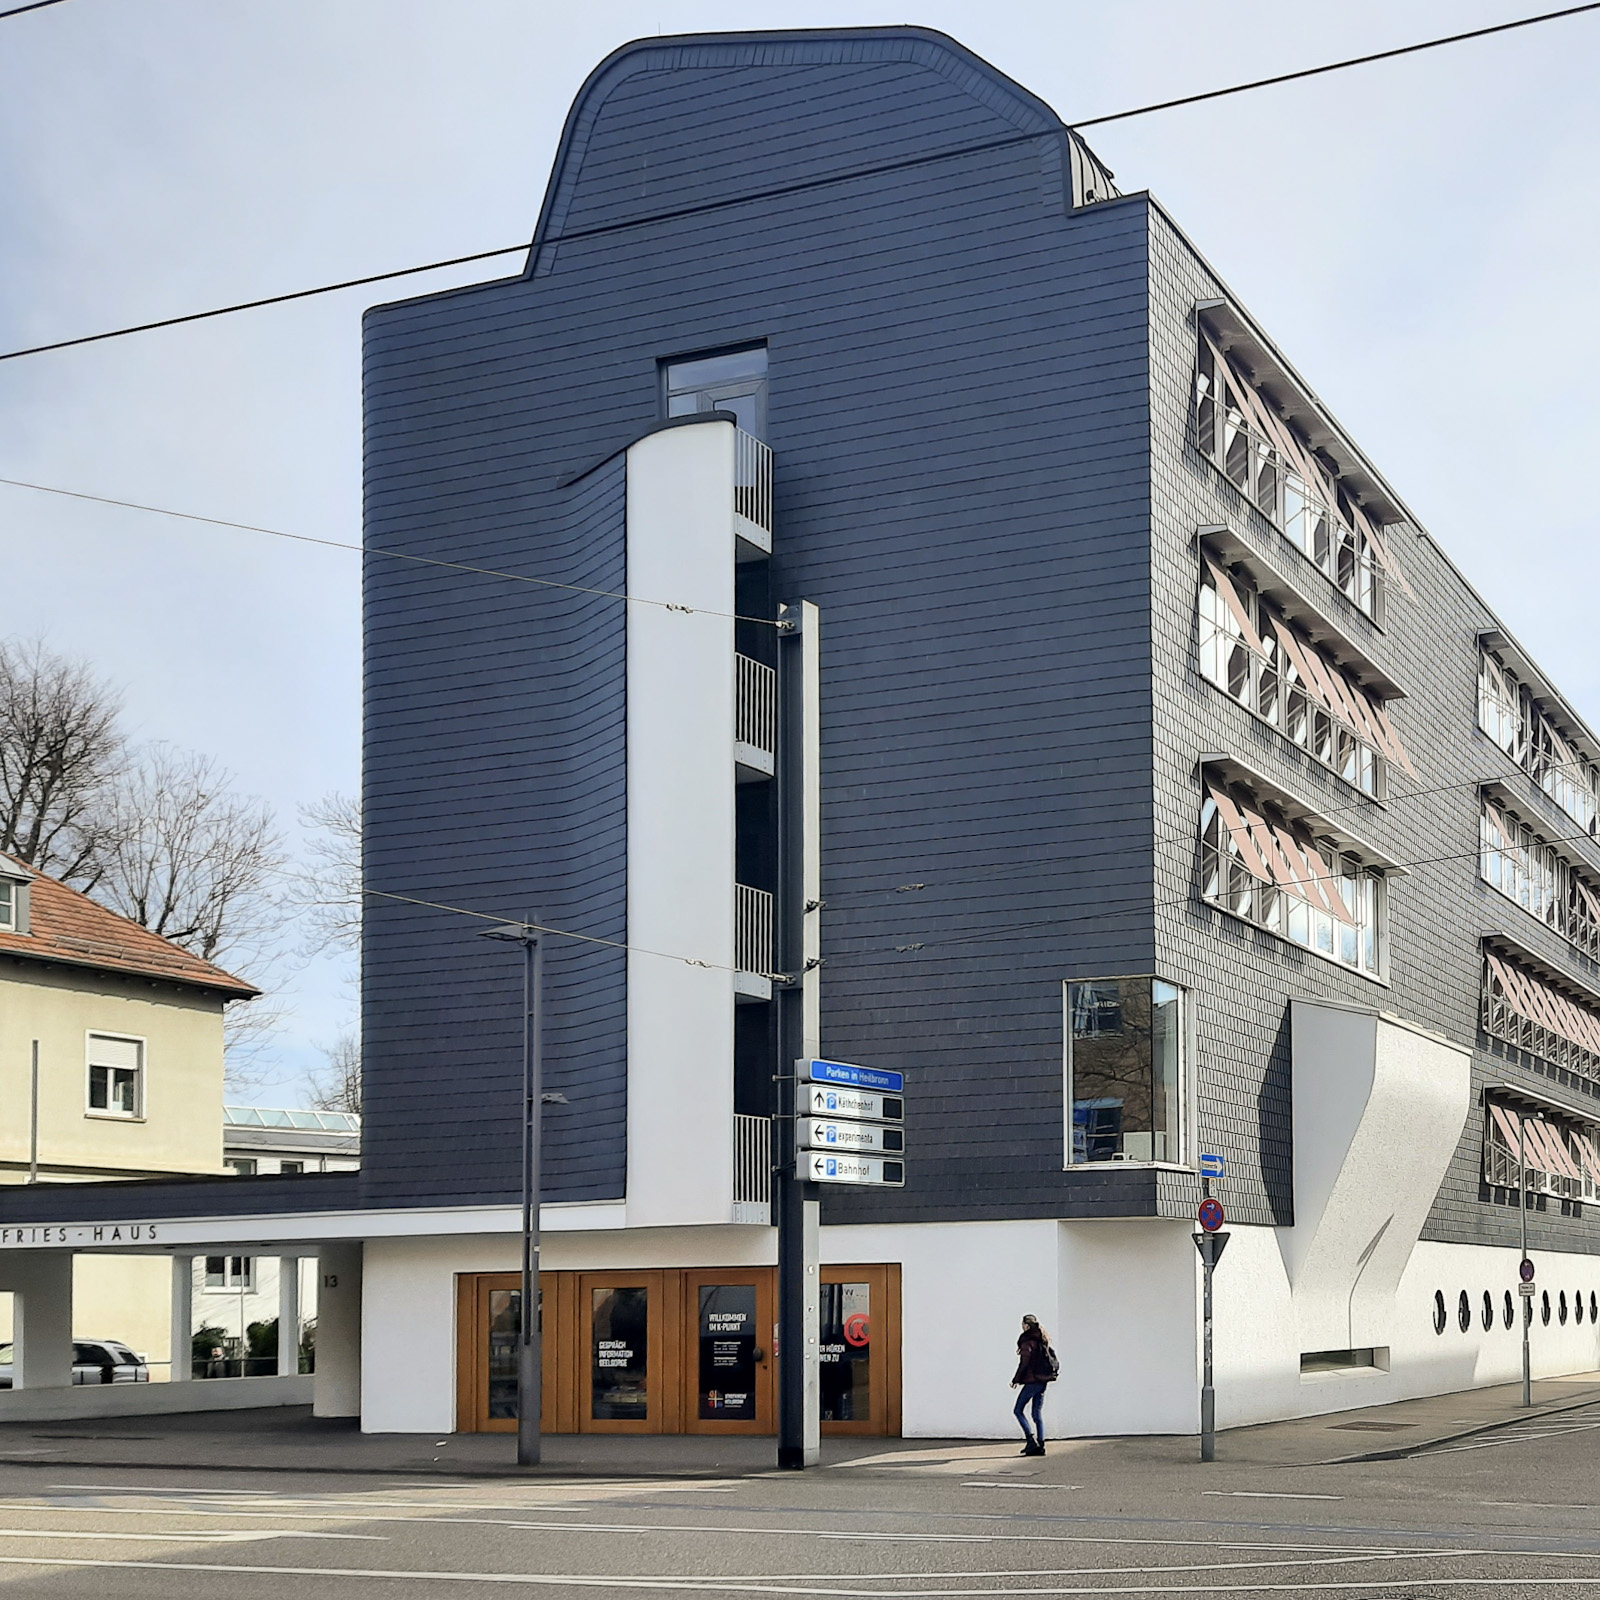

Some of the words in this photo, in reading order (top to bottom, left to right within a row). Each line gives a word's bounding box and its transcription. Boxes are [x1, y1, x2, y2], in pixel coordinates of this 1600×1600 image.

[826, 1066, 850, 1080] Parken
[851, 1070, 858, 1081] in
[859, 1073, 889, 1086] Heilbronn
[838, 1097, 874, 1112] Käthchenhof
[838, 1131, 873, 1144] experimenta
[838, 1162, 870, 1176] Bahnhof
[324, 1274, 339, 1289] 13
[826, 1344, 845, 1353] HÖREN
[832, 1354, 840, 1362] ZU
